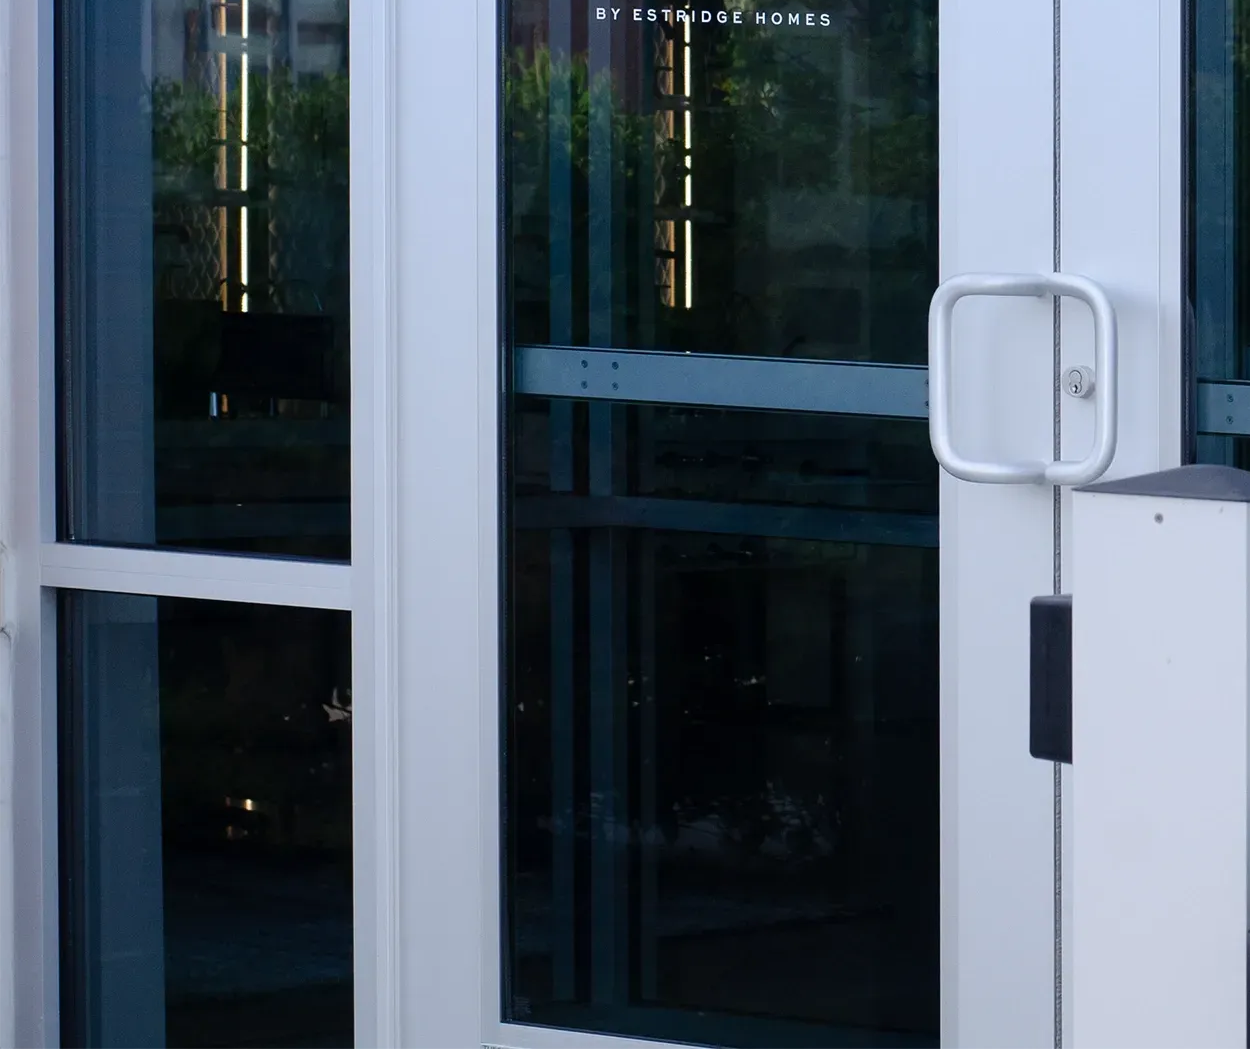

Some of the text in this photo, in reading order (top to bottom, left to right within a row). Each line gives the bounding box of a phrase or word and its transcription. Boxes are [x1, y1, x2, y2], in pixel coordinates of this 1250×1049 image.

[596, 7, 831, 27] BY ESTRIDGE HOMES
